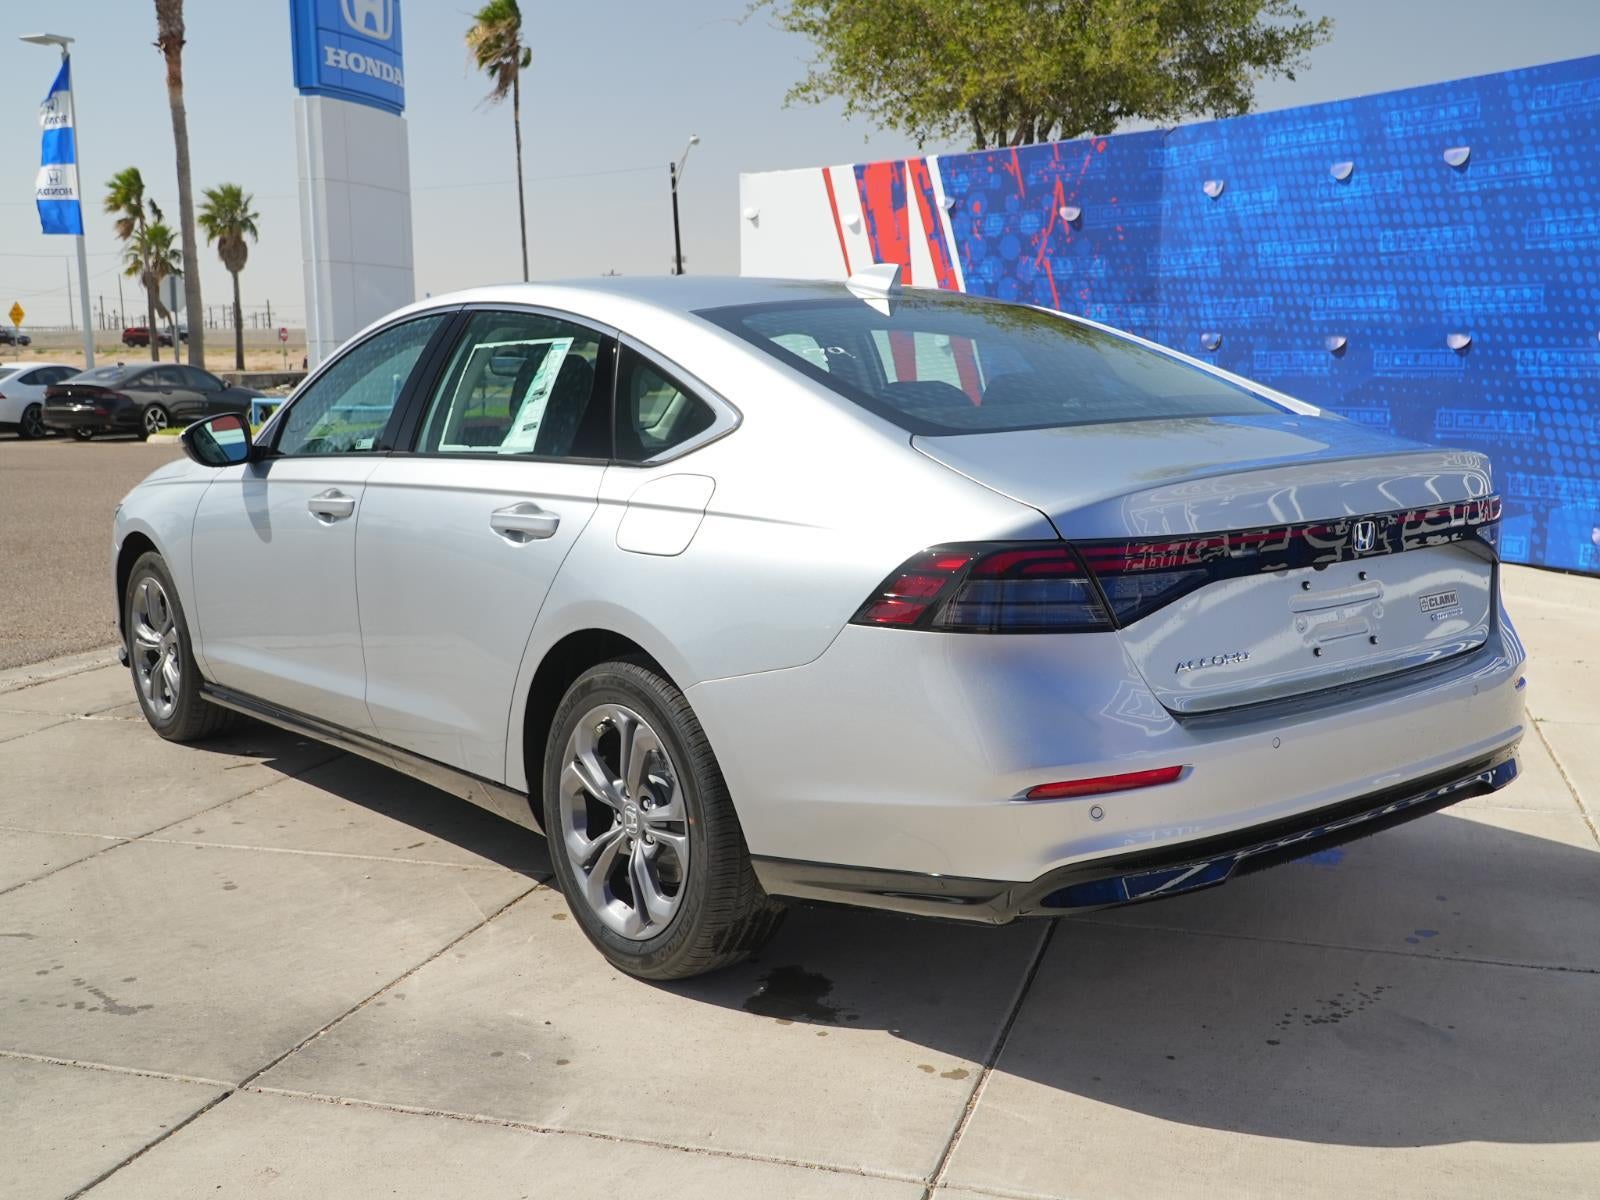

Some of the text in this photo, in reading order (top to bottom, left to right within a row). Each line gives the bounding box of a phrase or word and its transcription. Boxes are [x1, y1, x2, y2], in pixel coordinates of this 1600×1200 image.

[324, 46, 404, 88] HONDA
[1457, 414, 1530, 429] CLARK
[1429, 593, 1456, 607] CLARK
